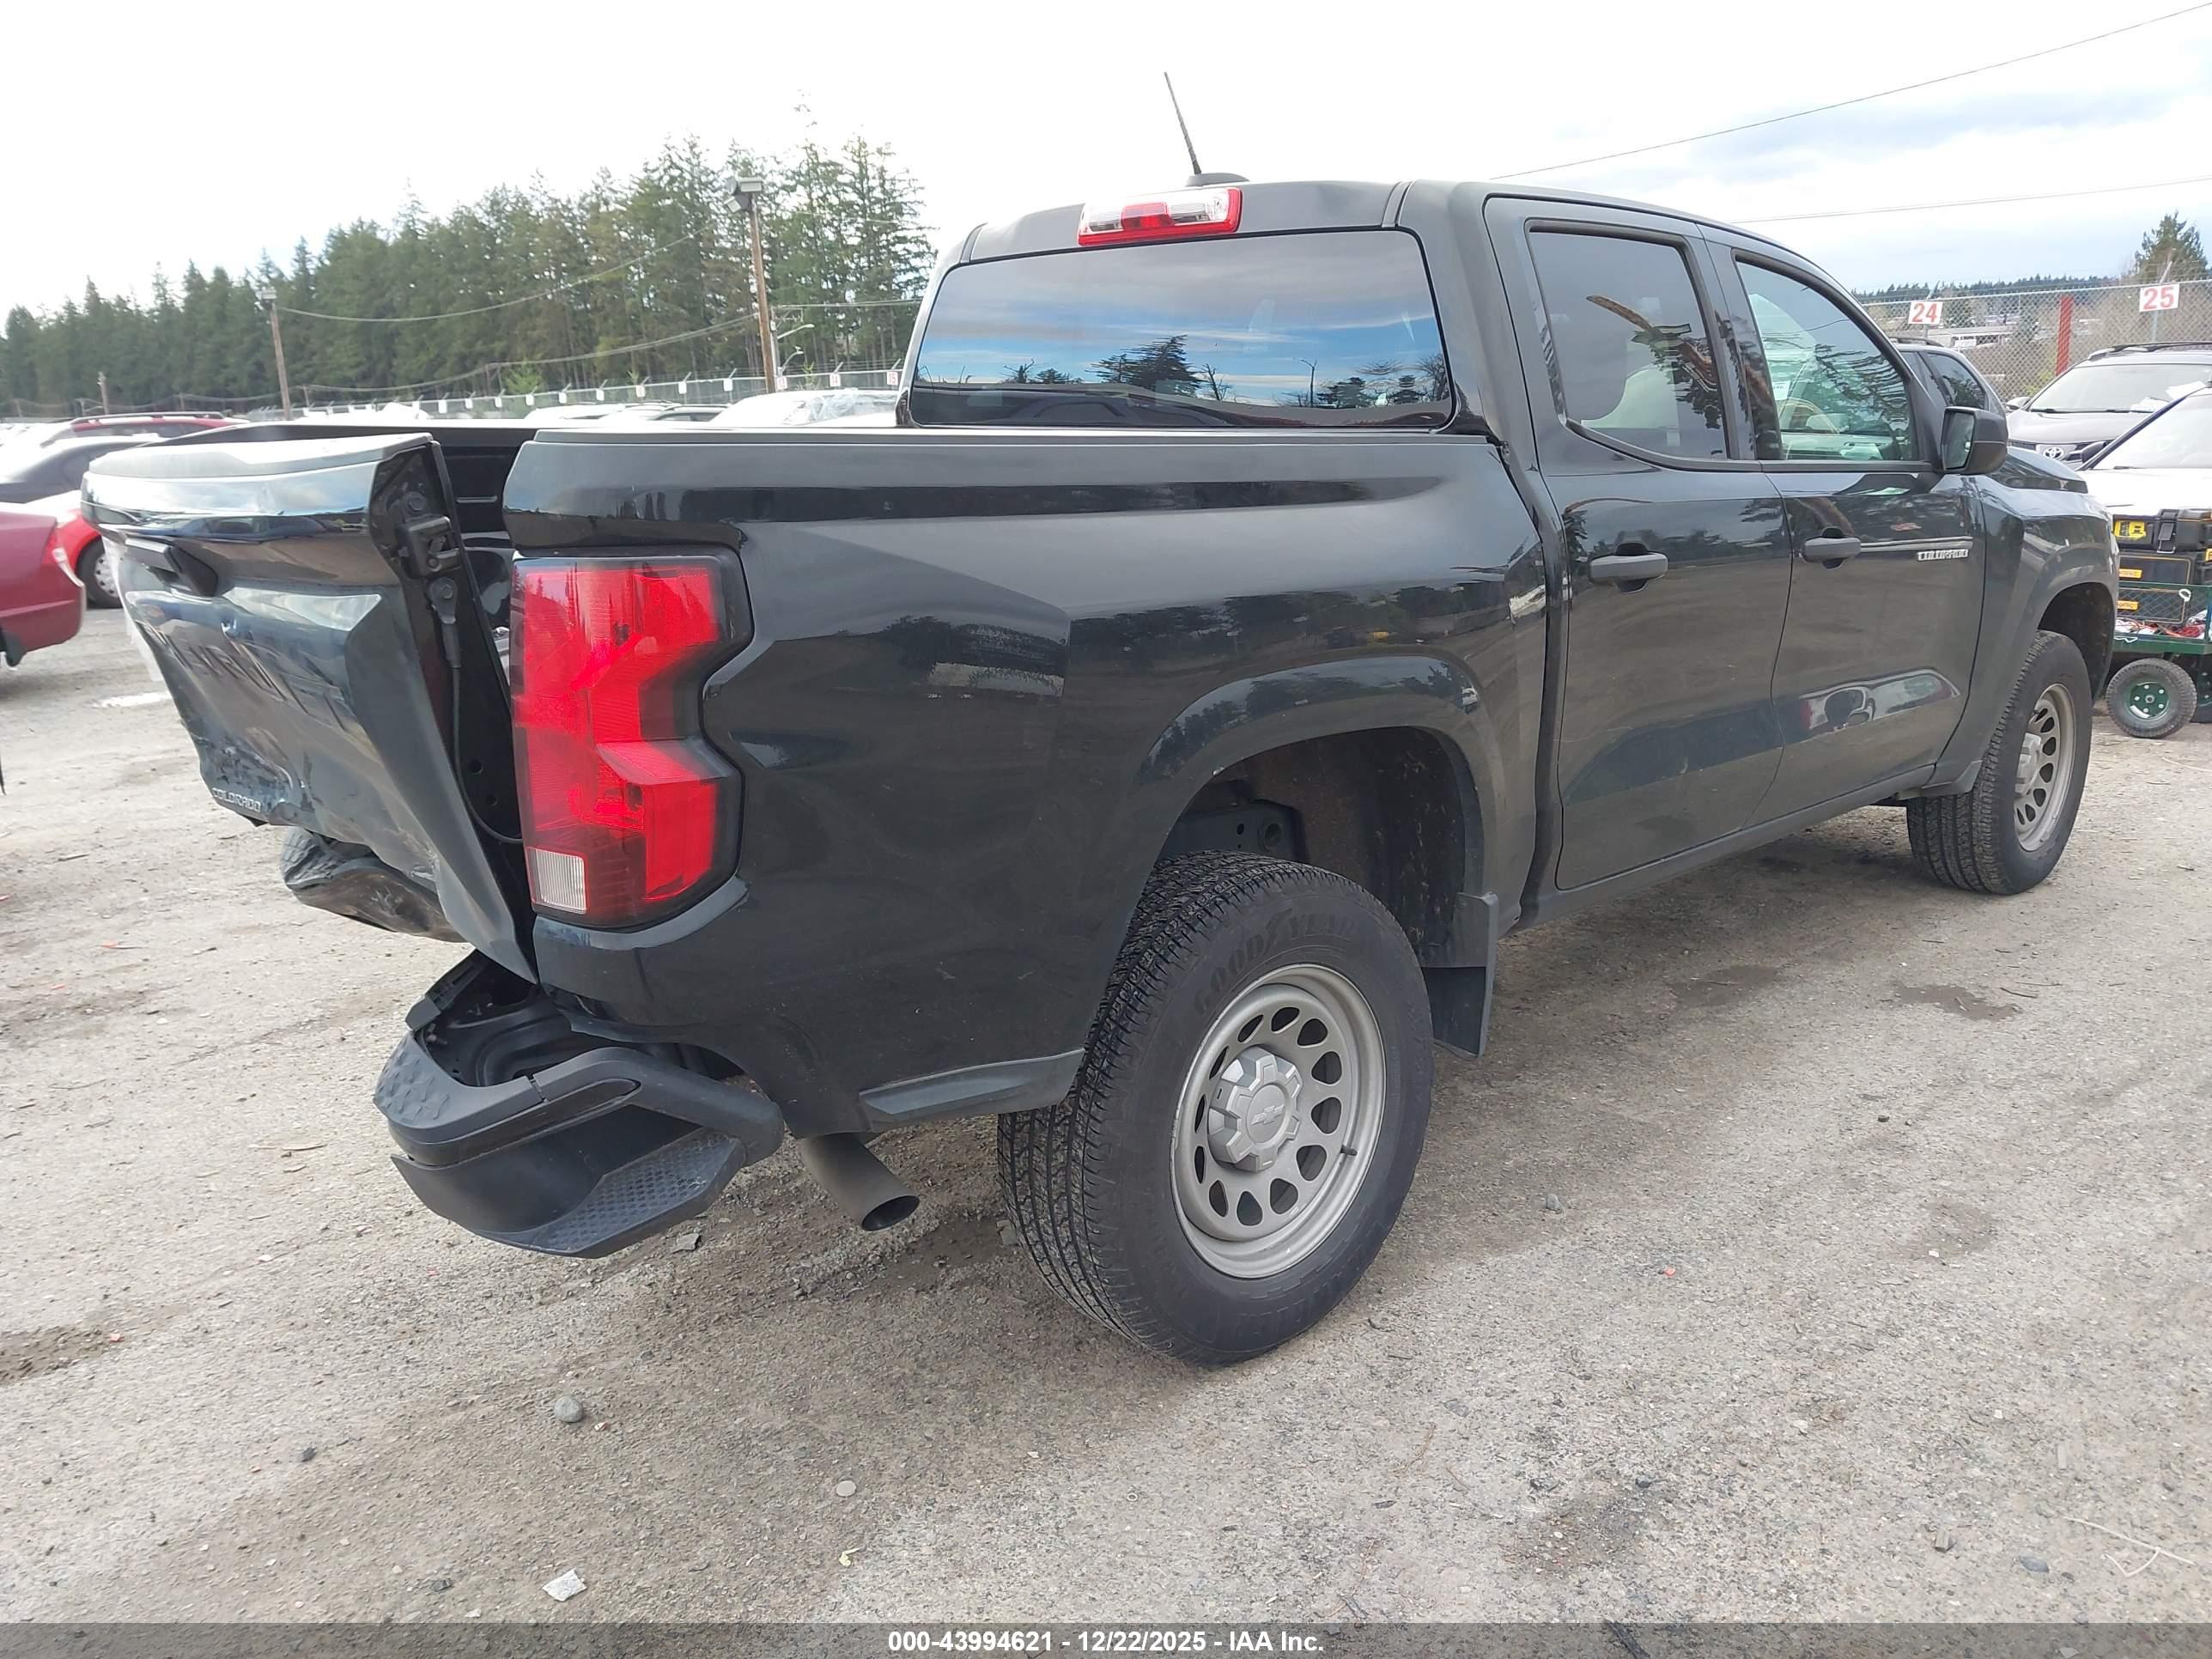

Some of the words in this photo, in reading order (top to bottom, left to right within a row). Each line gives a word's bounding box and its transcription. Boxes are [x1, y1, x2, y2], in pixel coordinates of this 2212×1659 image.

[2143, 286, 2174, 310] 25
[1911, 302, 1938, 323] 24
[831, 375, 839, 386] 14
[888, 373, 897, 385] 15
[1917, 549, 1969, 562] COLORADO
[211, 787, 261, 813] COLORADO
[1194, 907, 1356, 1015] GOODYEAR
